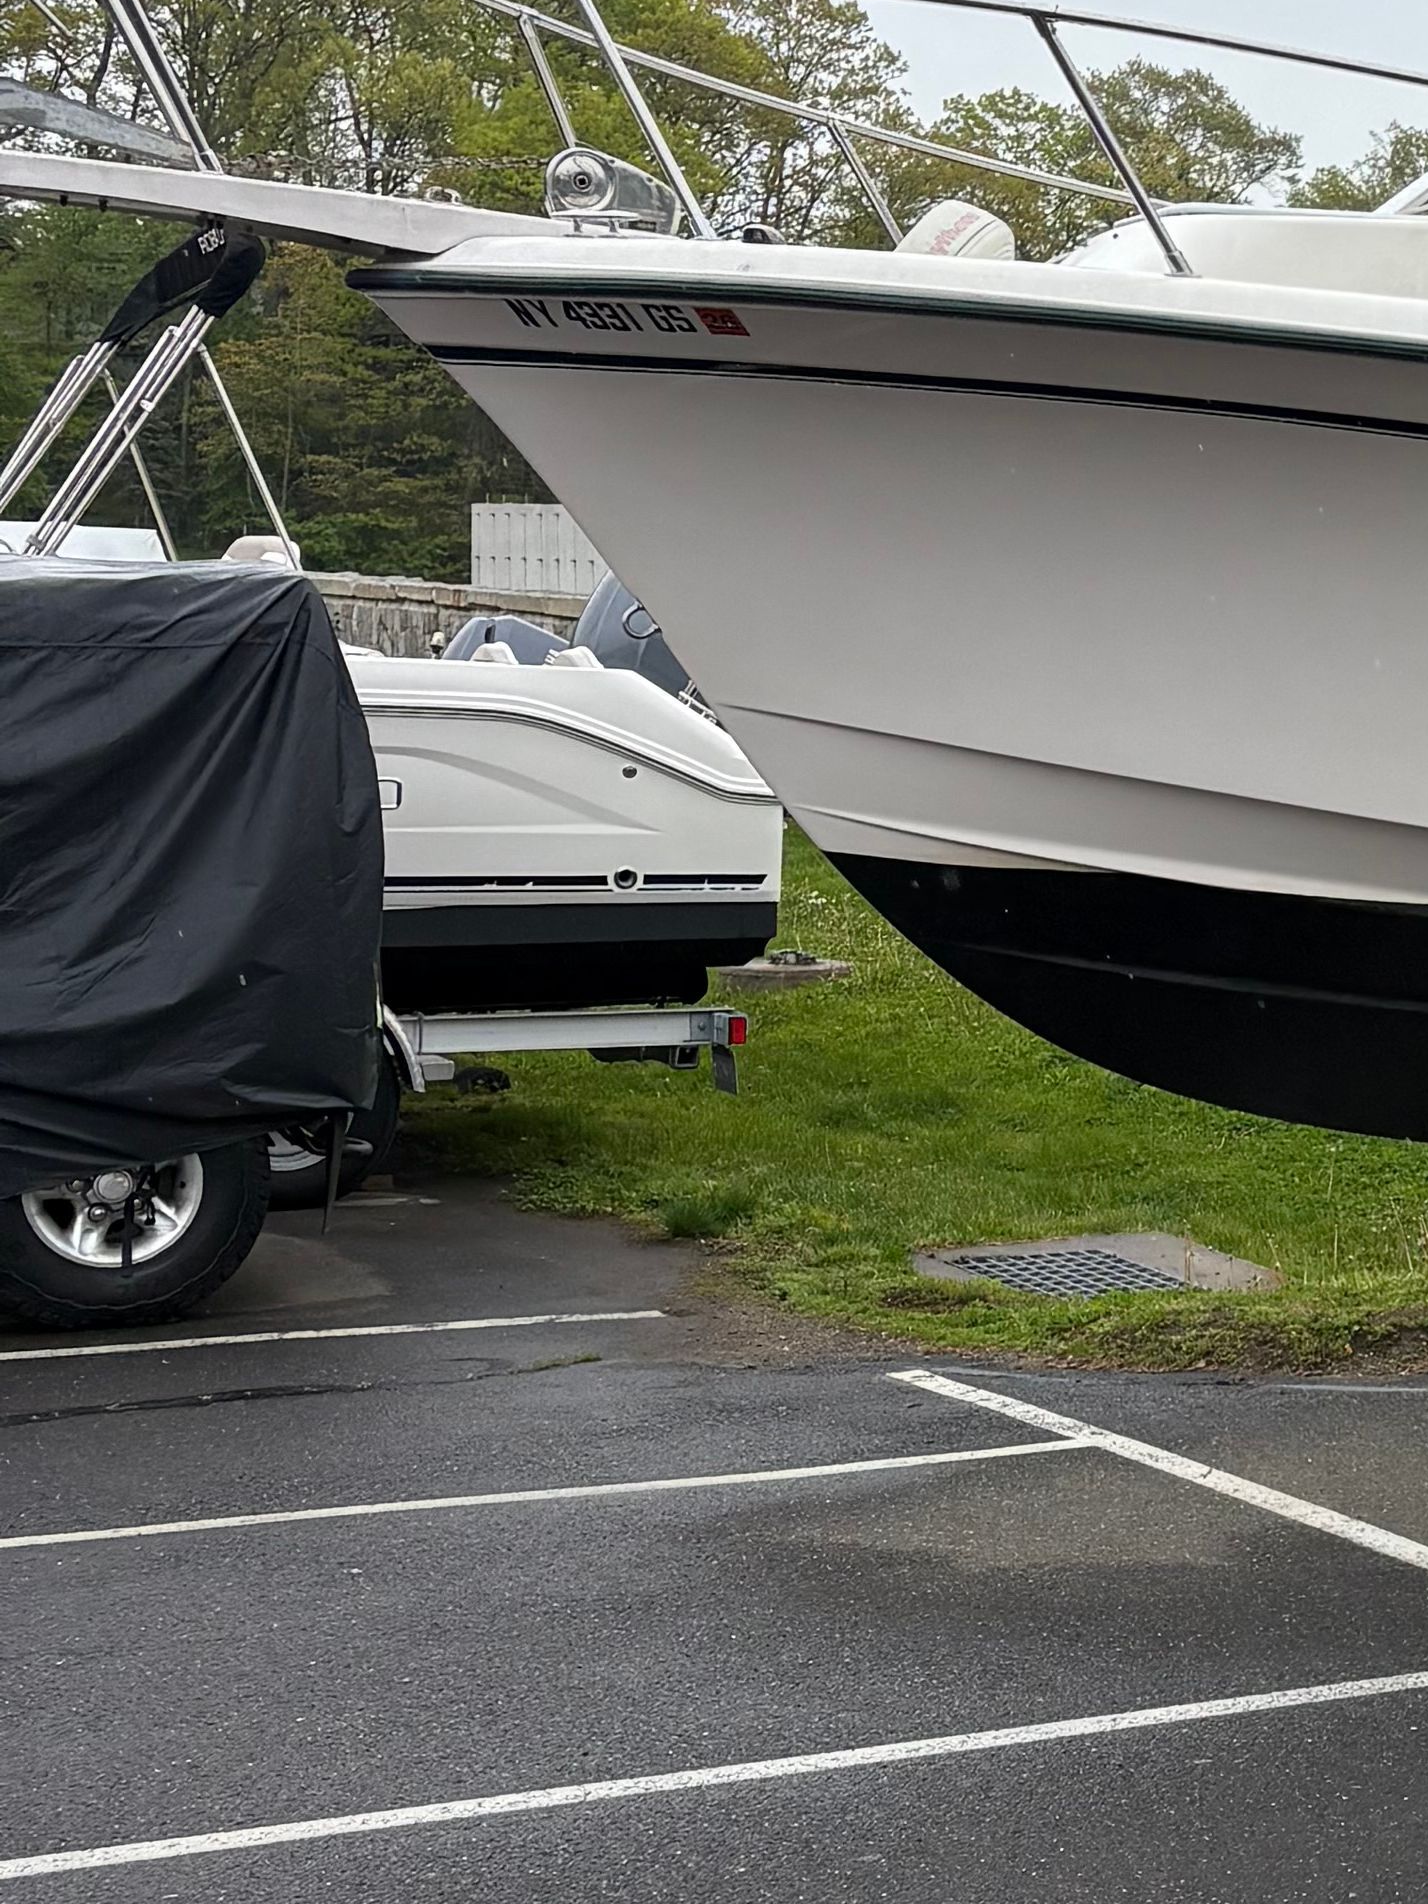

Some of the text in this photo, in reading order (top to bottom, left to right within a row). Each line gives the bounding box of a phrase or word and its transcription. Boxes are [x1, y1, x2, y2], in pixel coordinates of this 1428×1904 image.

[502, 298, 698, 333] NY 4331 GS
